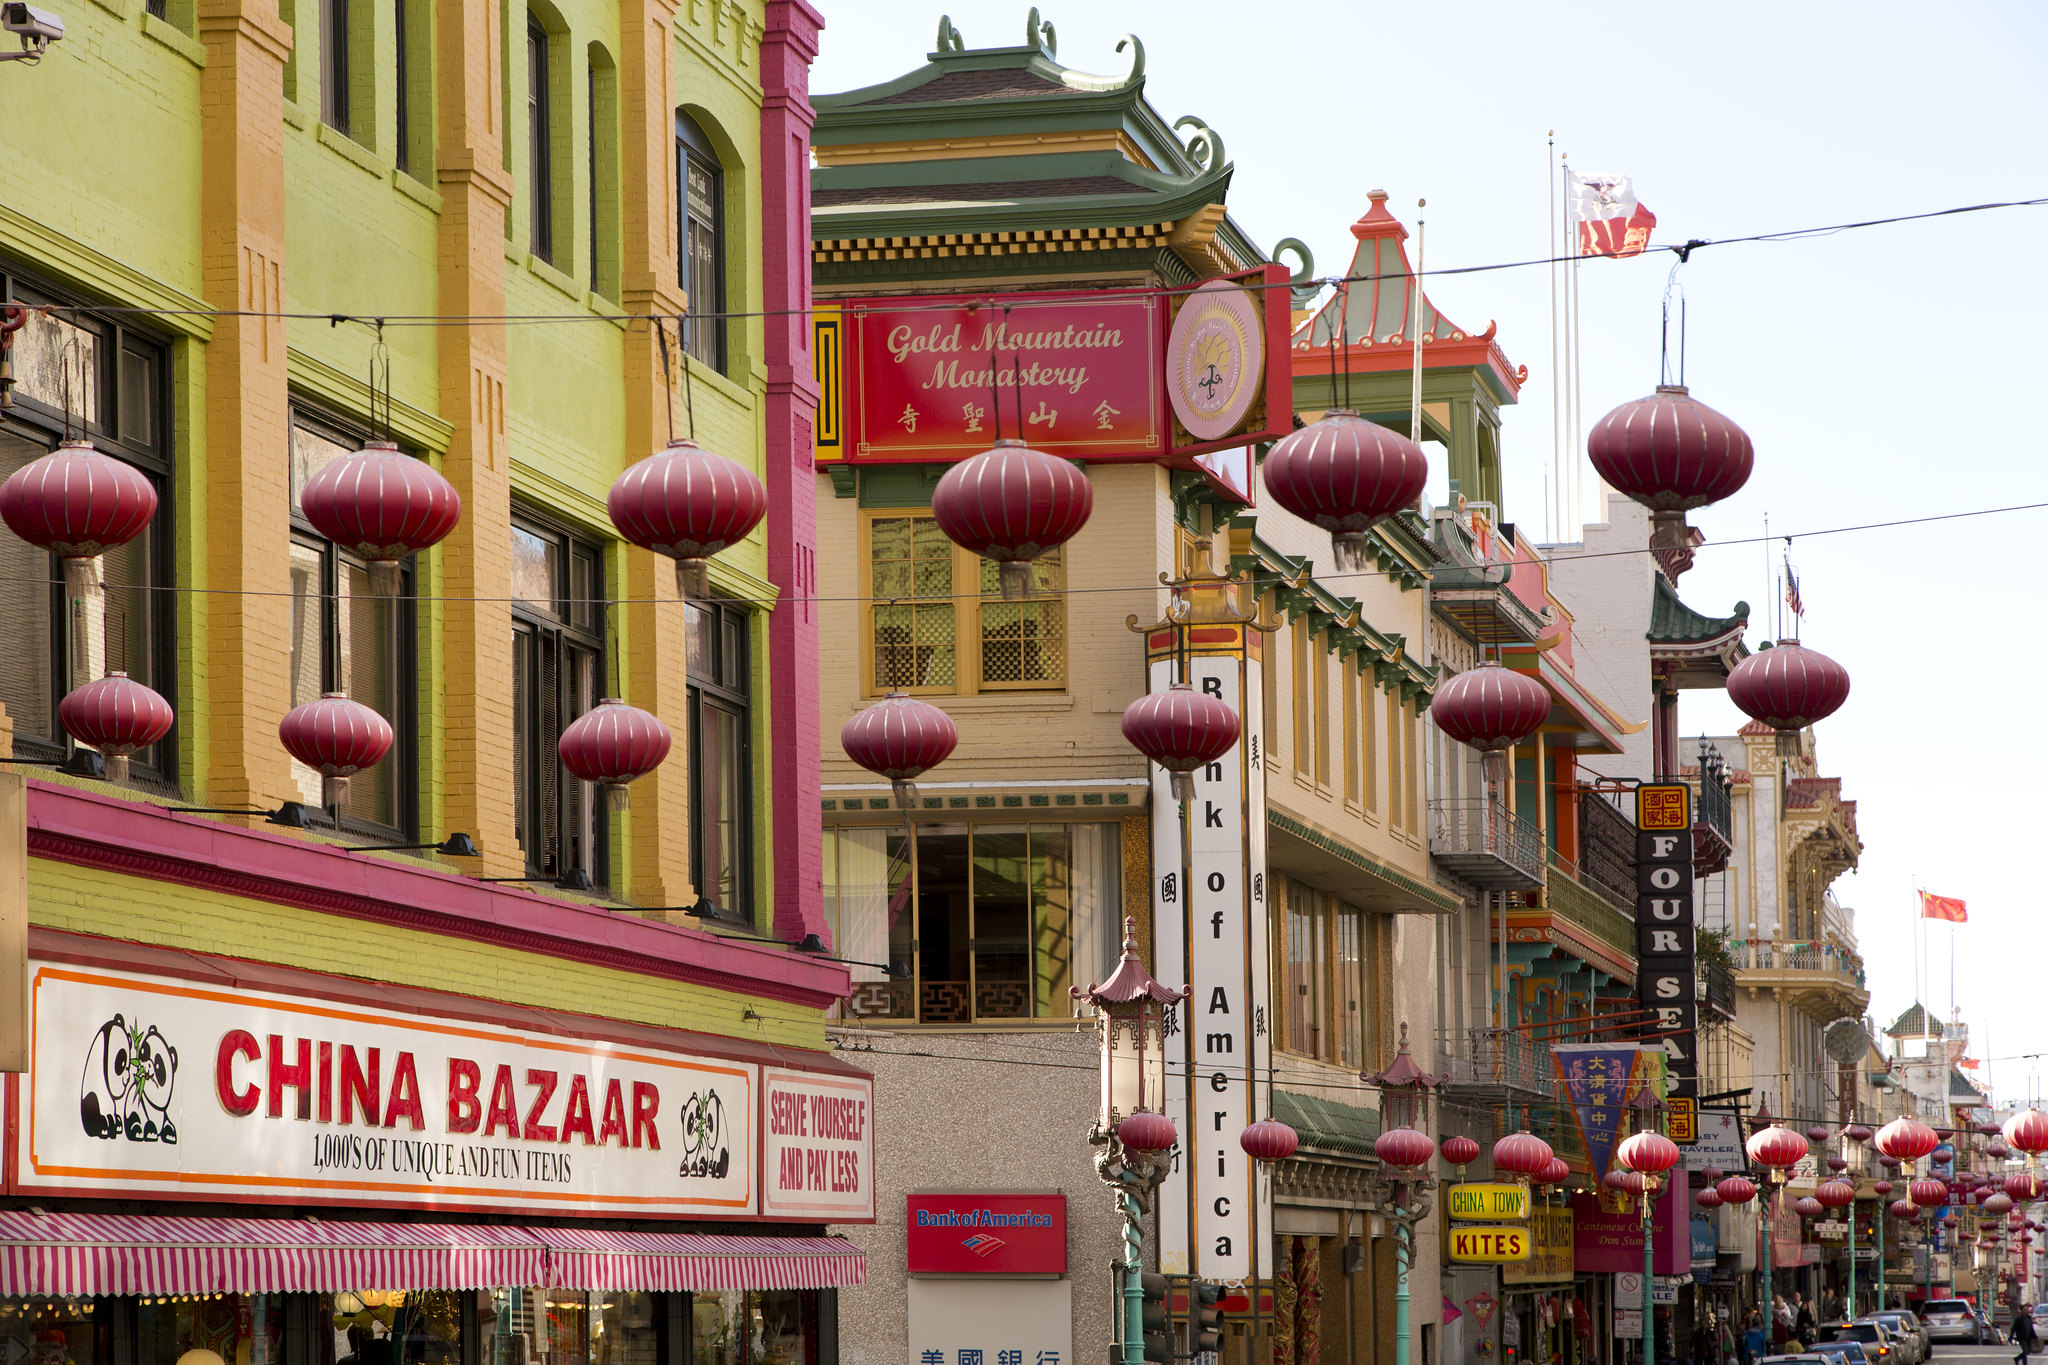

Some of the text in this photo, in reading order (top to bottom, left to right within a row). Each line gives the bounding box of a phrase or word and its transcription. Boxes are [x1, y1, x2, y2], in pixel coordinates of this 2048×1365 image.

[887, 322, 1124, 363] Gold Mountain
[922, 360, 1090, 394] Monastery
[1202, 677, 1224, 827] Bnk
[1207, 872, 1225, 939] of
[1650, 835, 1682, 952] FOUR
[215, 1029, 661, 1150] CHINA BAZAAR
[1843, 1071, 1853, 1121] GIFTS
[771, 1089, 865, 1142] SERVE YOURSELF
[1206, 986, 1233, 1256] America
[313, 1132, 571, 1184] 1,000'S OF UNIQUE AND FUN ITEMS
[779, 1147, 858, 1193] AND PAY LESS
[917, 1209, 1052, 1228] Bank of America
[1453, 1191, 1524, 1213] CHINA TOWN
[1577, 1220, 1626, 1232] Cantonese
[1456, 1234, 1521, 1255] KITES
[1597, 1235, 1644, 1247] Dim Sum
